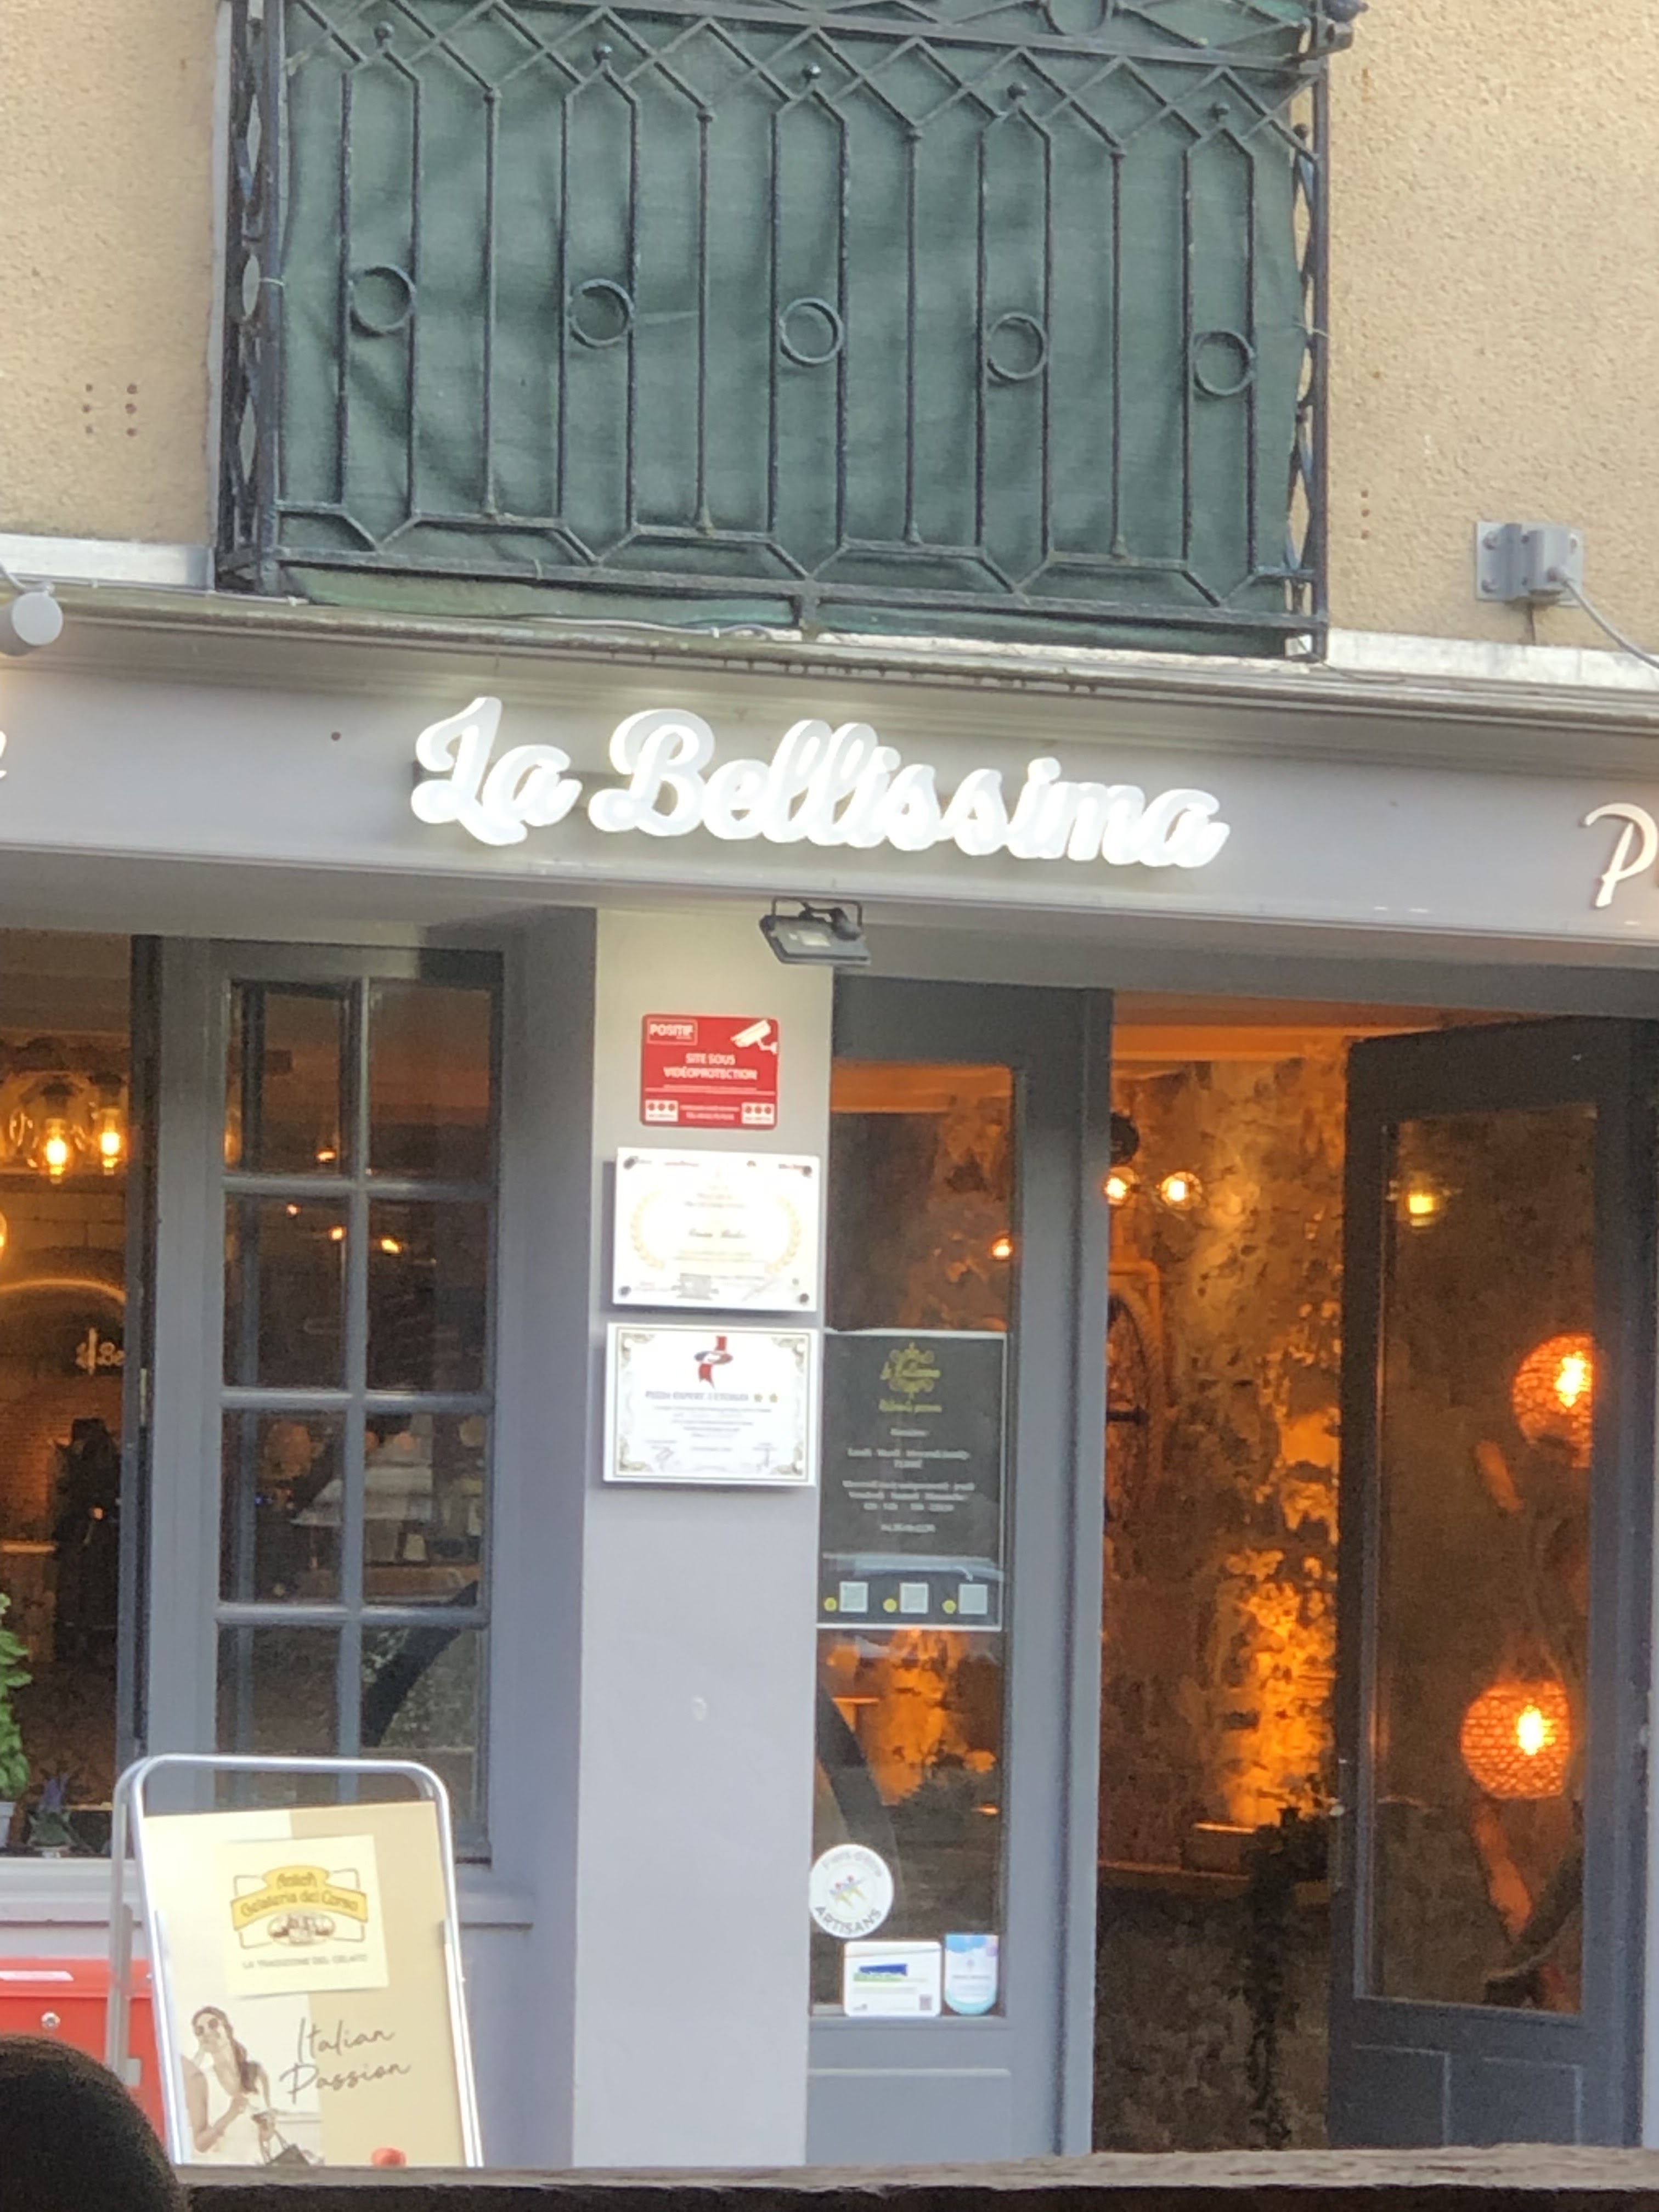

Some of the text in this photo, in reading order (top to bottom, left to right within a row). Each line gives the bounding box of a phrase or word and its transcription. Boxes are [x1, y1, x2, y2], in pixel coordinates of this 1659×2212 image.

[411, 696, 1230, 868] La Bellissima
[650, 1024, 693, 1036] POSITIF
[686, 1053, 736, 1065] SITE SOUS
[297, 2017, 396, 2064] Italian
[279, 2062, 412, 2104] Passion
